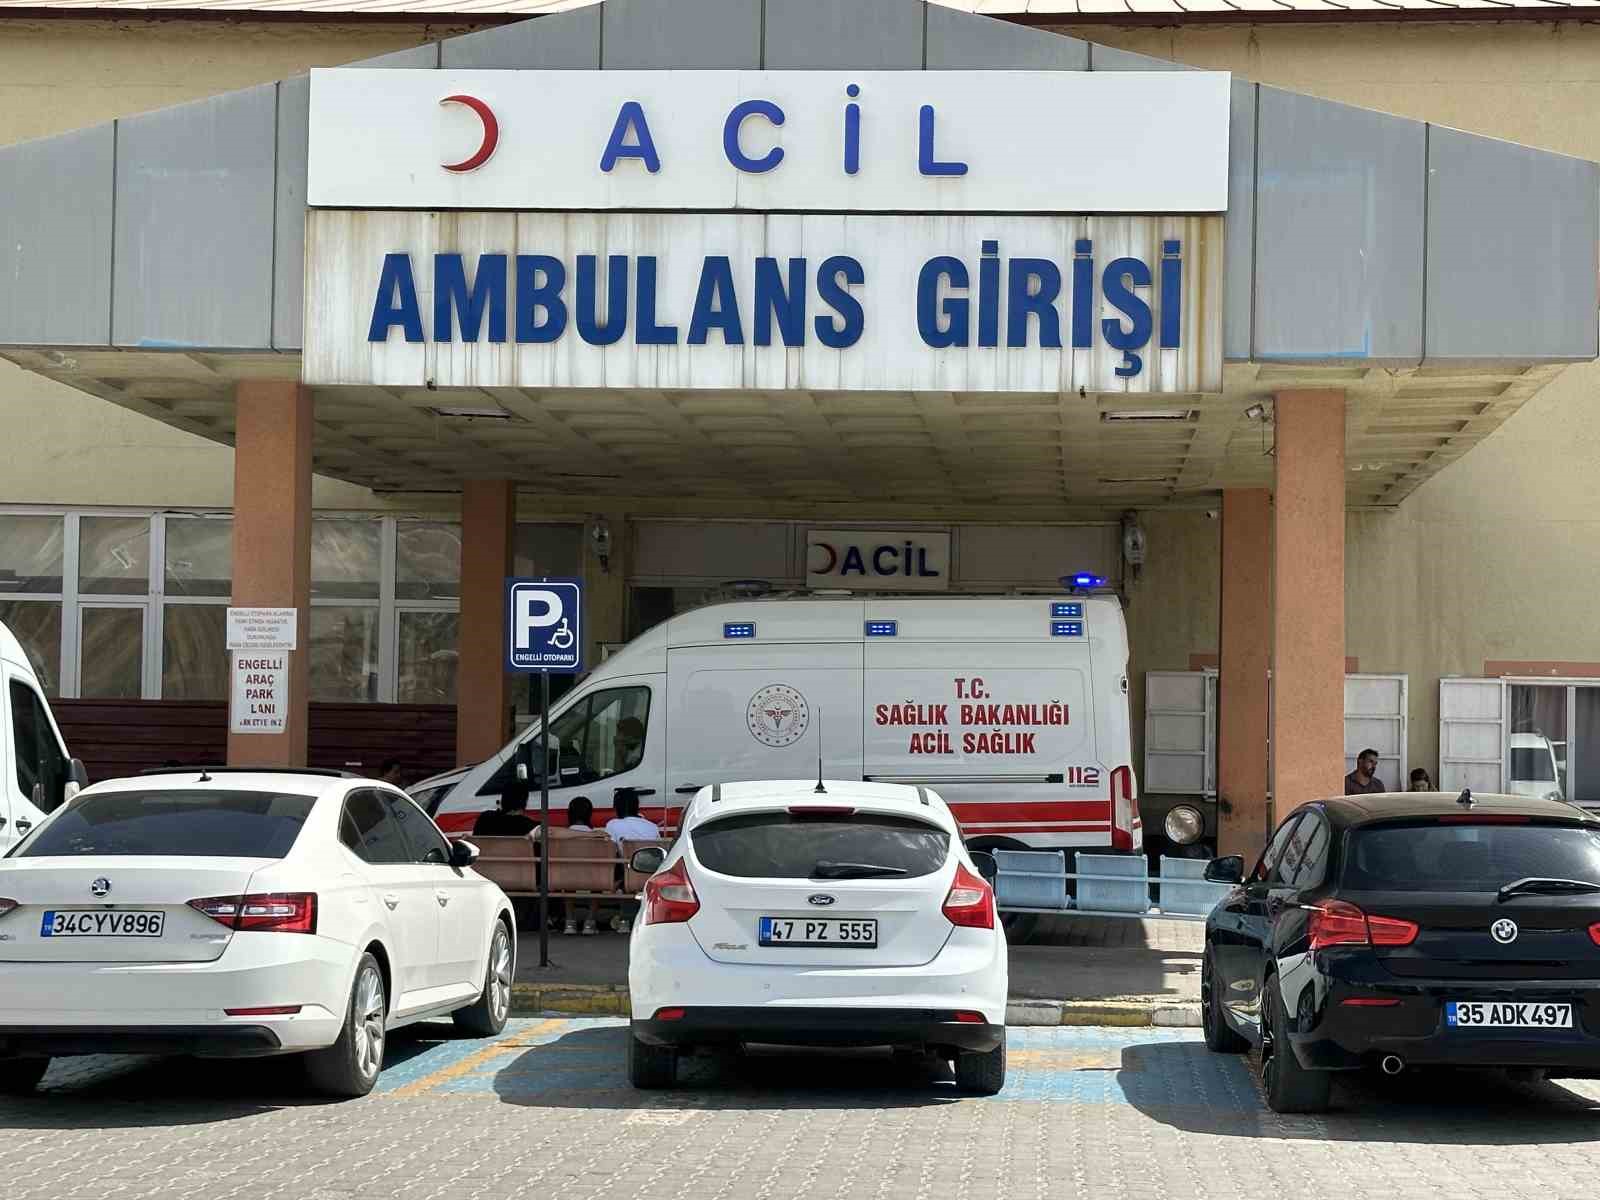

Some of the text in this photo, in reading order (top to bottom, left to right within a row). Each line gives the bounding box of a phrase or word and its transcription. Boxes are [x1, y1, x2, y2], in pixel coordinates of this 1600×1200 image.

[600, 84, 968, 176] ACİL
[367, 240, 1182, 377] AMBULANS GİRİŞİ
[840, 541, 939, 577] ACİL
[516, 590, 563, 648] P
[515, 653, 542, 662] ENGELLİ
[246, 674, 274, 687] ARAÇ
[954, 678, 990, 699] T.C.
[246, 688, 273, 700] PARK
[875, 699, 1070, 726] SAĞLIK BAKANLIĞI
[908, 728, 1036, 754] ACİL SAĞLIK
[1067, 766, 1100, 784] 112
[54, 914, 160, 933] 34CYV896
[772, 922, 873, 941] 47 PZ 555
[1457, 1004, 1484, 1025] 35
